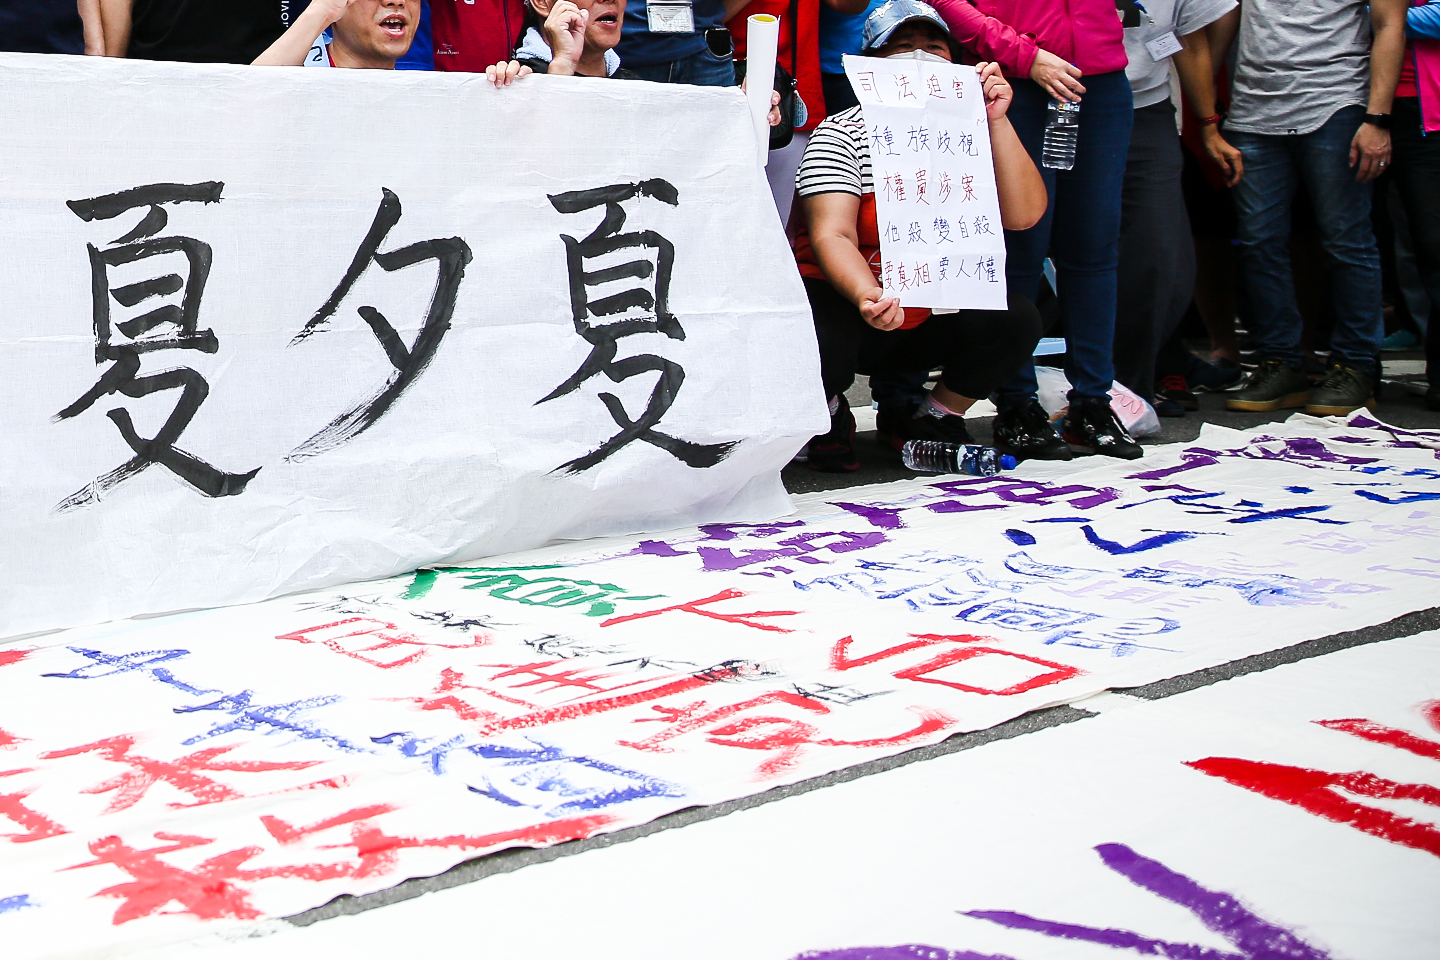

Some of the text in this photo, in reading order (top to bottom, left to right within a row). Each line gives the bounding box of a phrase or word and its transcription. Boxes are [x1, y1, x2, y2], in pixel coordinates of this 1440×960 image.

[856, 71, 964, 103] 司法迫害
[871, 124, 979, 157] 種族歧視
[883, 167, 979, 206] 權貴涉案
[884, 214, 996, 246] 他殺變自殺
